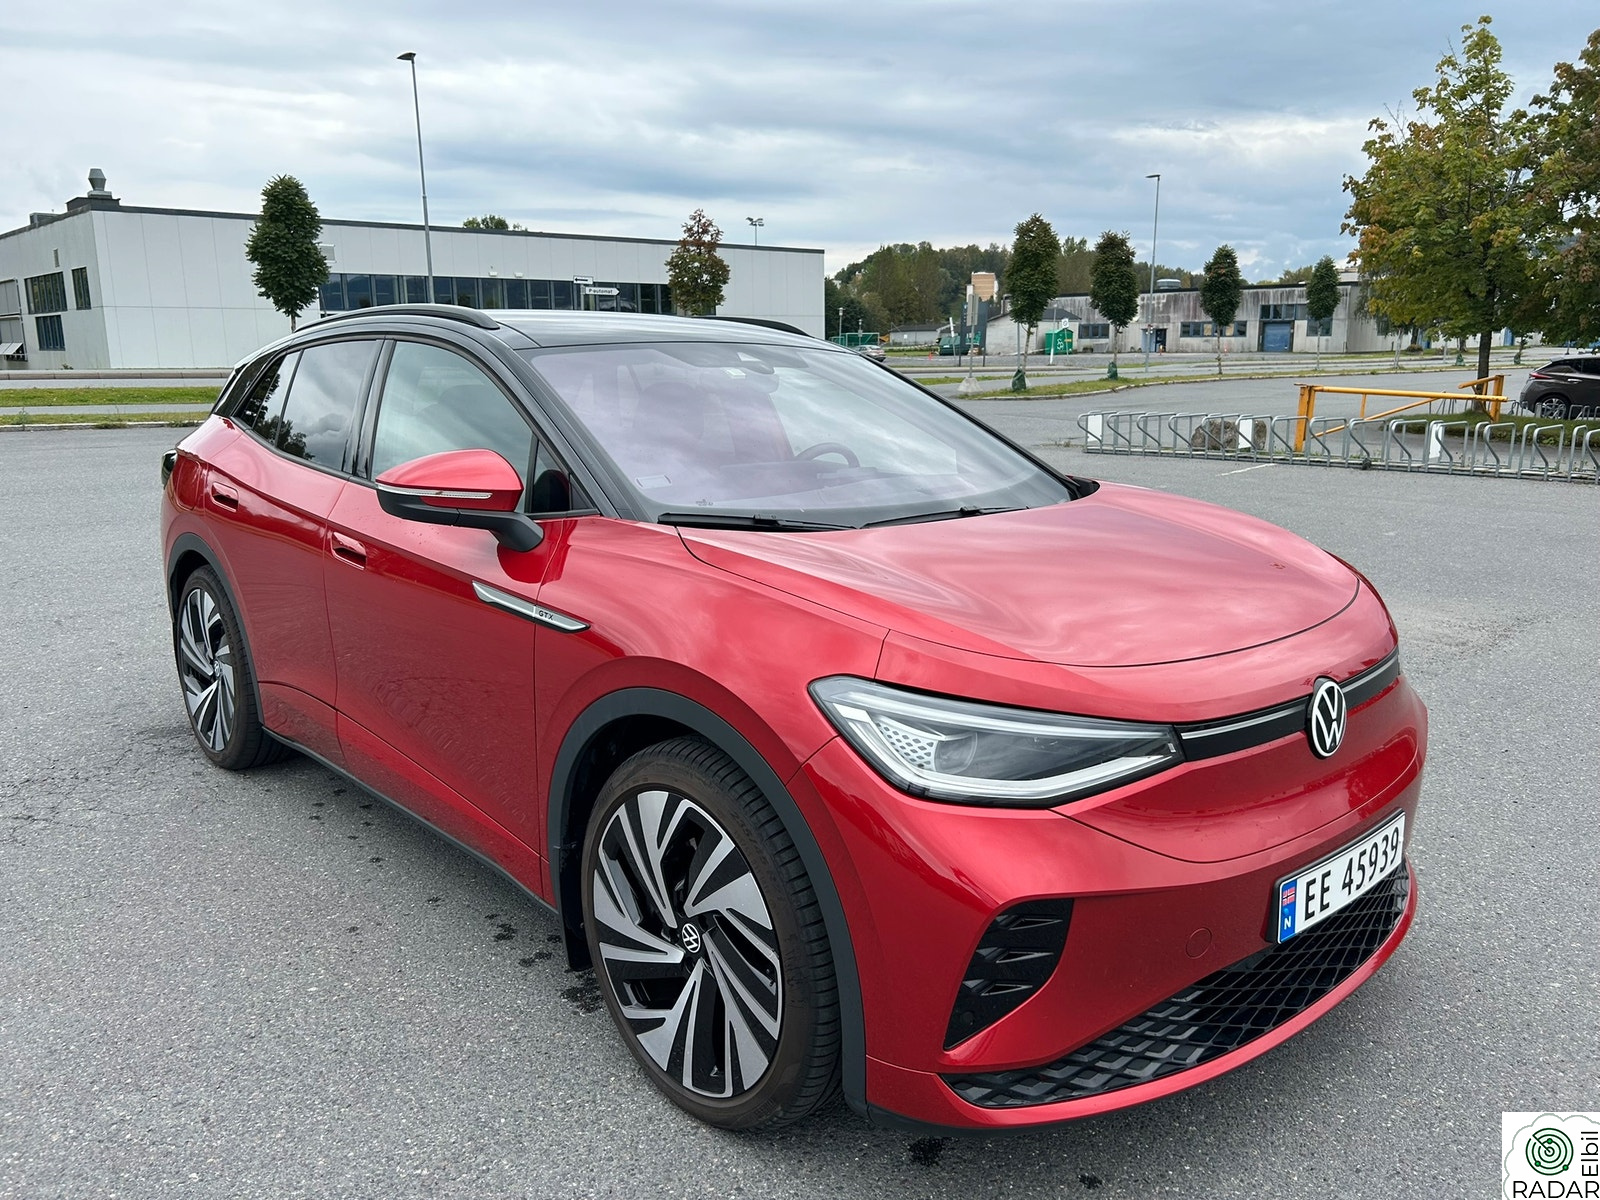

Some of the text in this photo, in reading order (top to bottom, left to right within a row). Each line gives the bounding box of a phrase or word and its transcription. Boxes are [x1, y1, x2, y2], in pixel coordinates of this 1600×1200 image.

[538, 610, 554, 620] GTX
[1304, 827, 1399, 921] EE 45939
[1284, 916, 1292, 930] N
